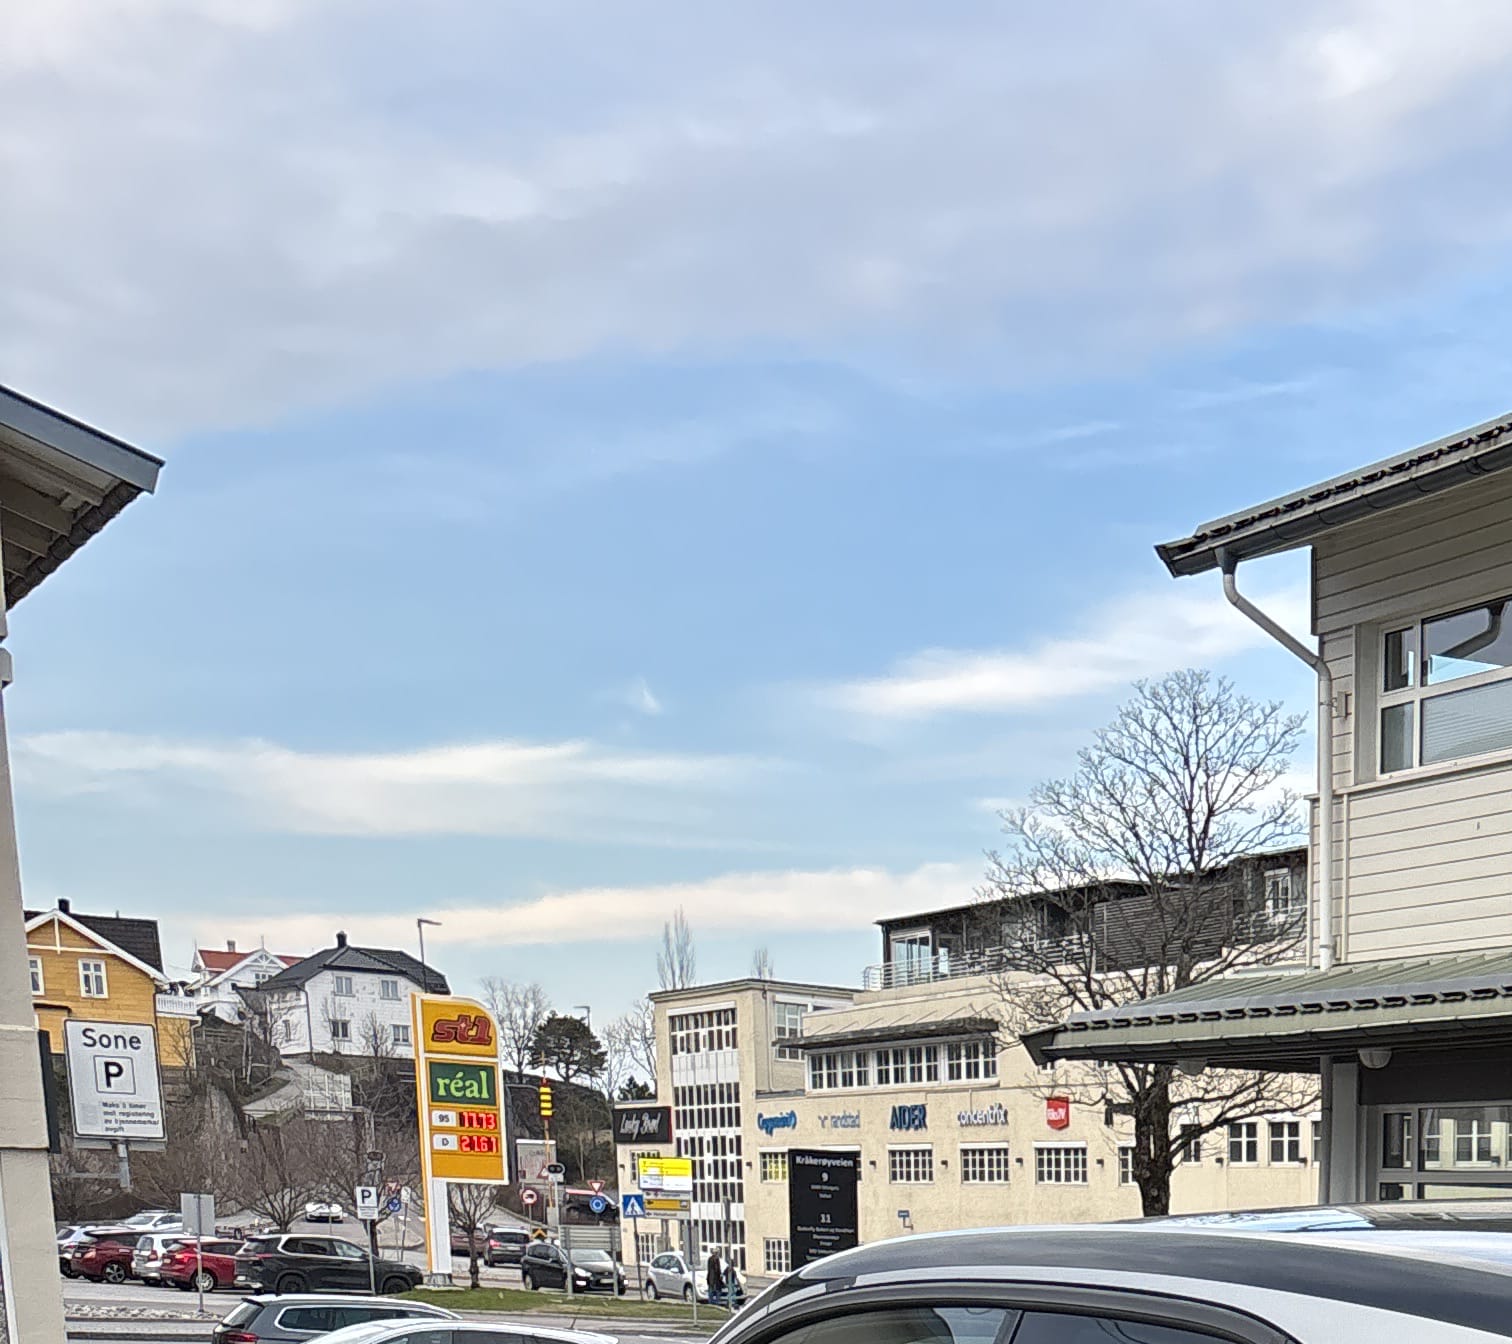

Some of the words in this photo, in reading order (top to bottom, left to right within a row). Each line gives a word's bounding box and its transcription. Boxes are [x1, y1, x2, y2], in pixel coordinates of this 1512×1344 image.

[82, 1028, 142, 1050] Sone
[431, 1014, 493, 1046] st1
[104, 1061, 124, 1088] P
[436, 1070, 490, 1099] réal
[796, 1155, 854, 1167] Kråkerøyveien
[822, 1172, 829, 1182] 9
[361, 1189, 372, 1204] P
